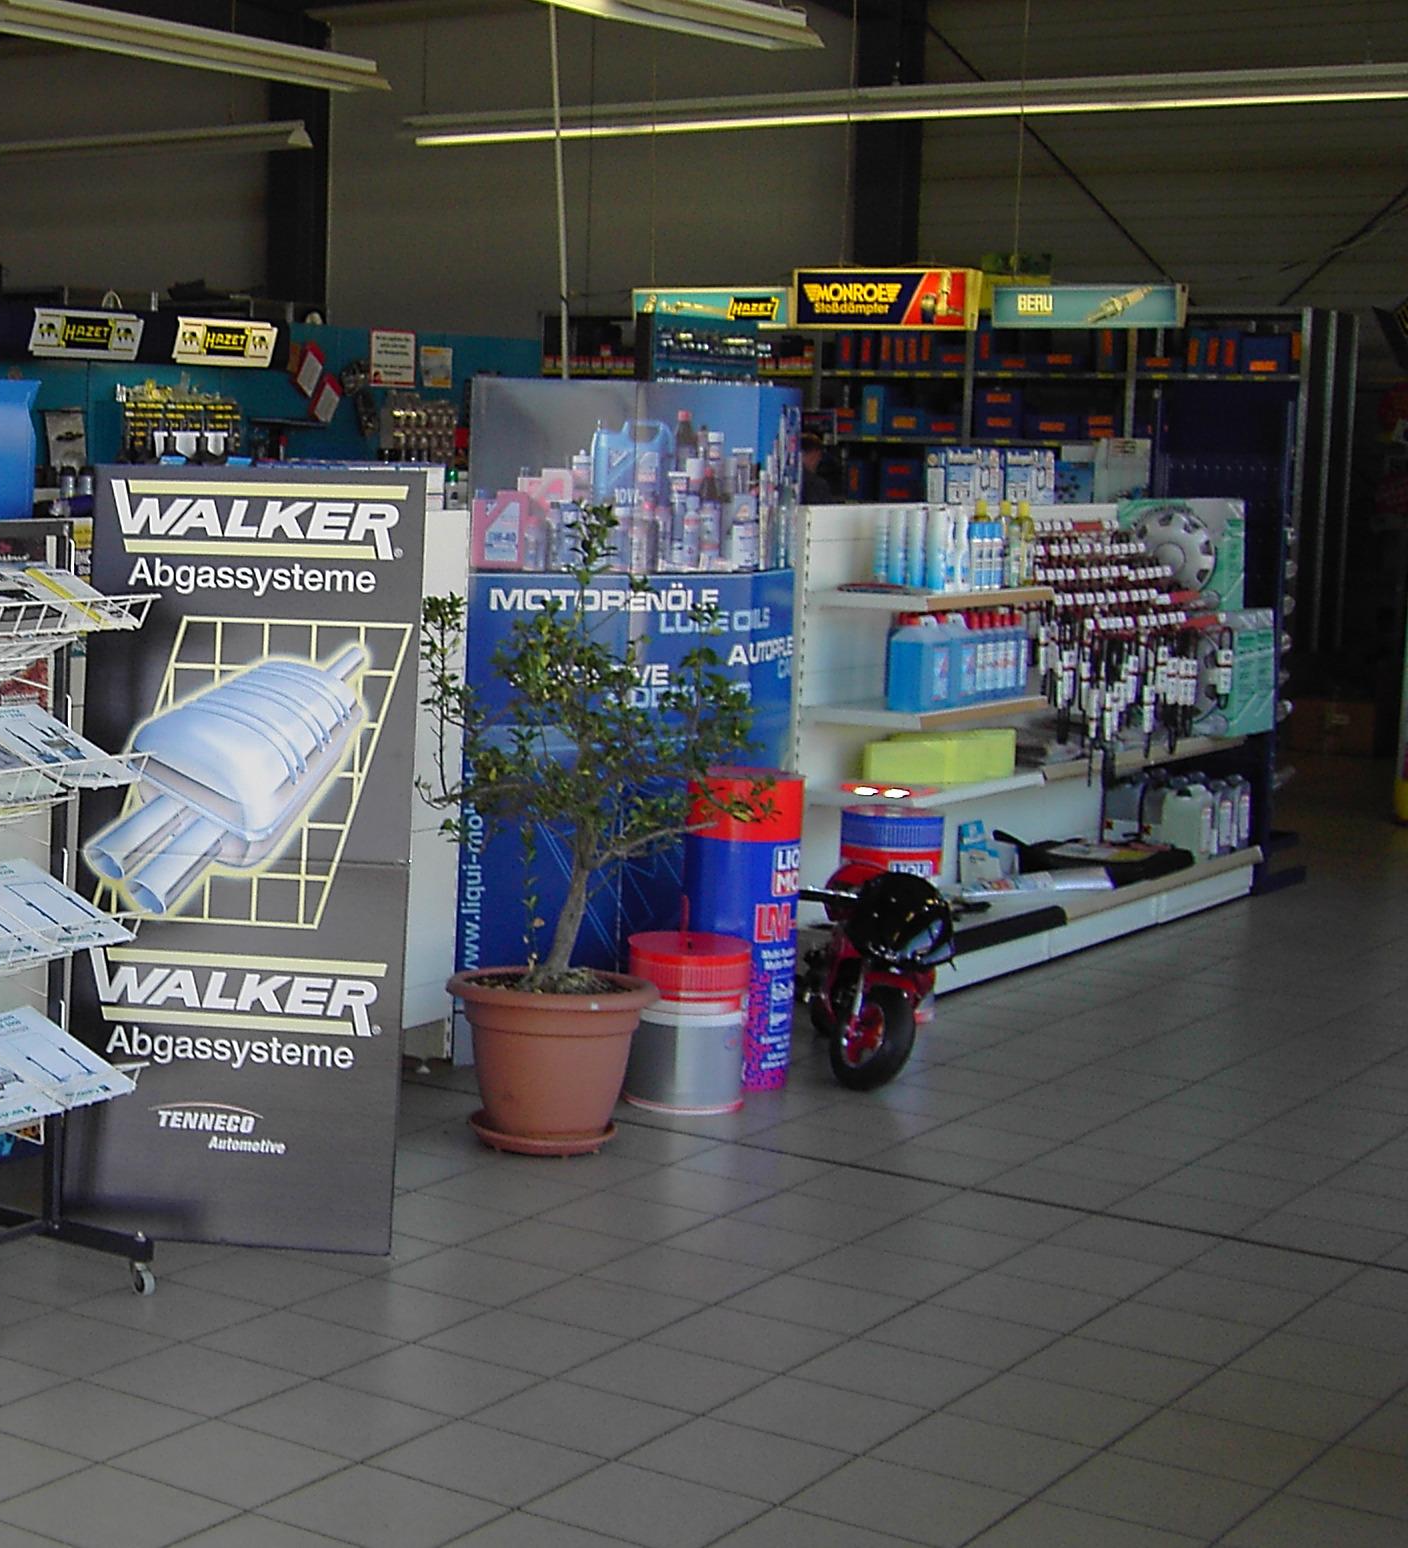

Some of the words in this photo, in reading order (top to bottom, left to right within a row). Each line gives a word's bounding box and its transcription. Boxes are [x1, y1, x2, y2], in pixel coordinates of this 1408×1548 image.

[816, 283, 889, 302] MONROE
[731, 301, 774, 317] HAZET
[65, 322, 110, 342] HAZET
[205, 333, 247, 349] HAZET
[111, 479, 400, 561] WALKER
[128, 557, 377, 597] Abgassysteme
[89, 946, 379, 1037] WALKER
[106, 1024, 355, 1070] Abgassysteme
[156, 1110, 258, 1135] TENNECO
[208, 1135, 287, 1155] Automotive
